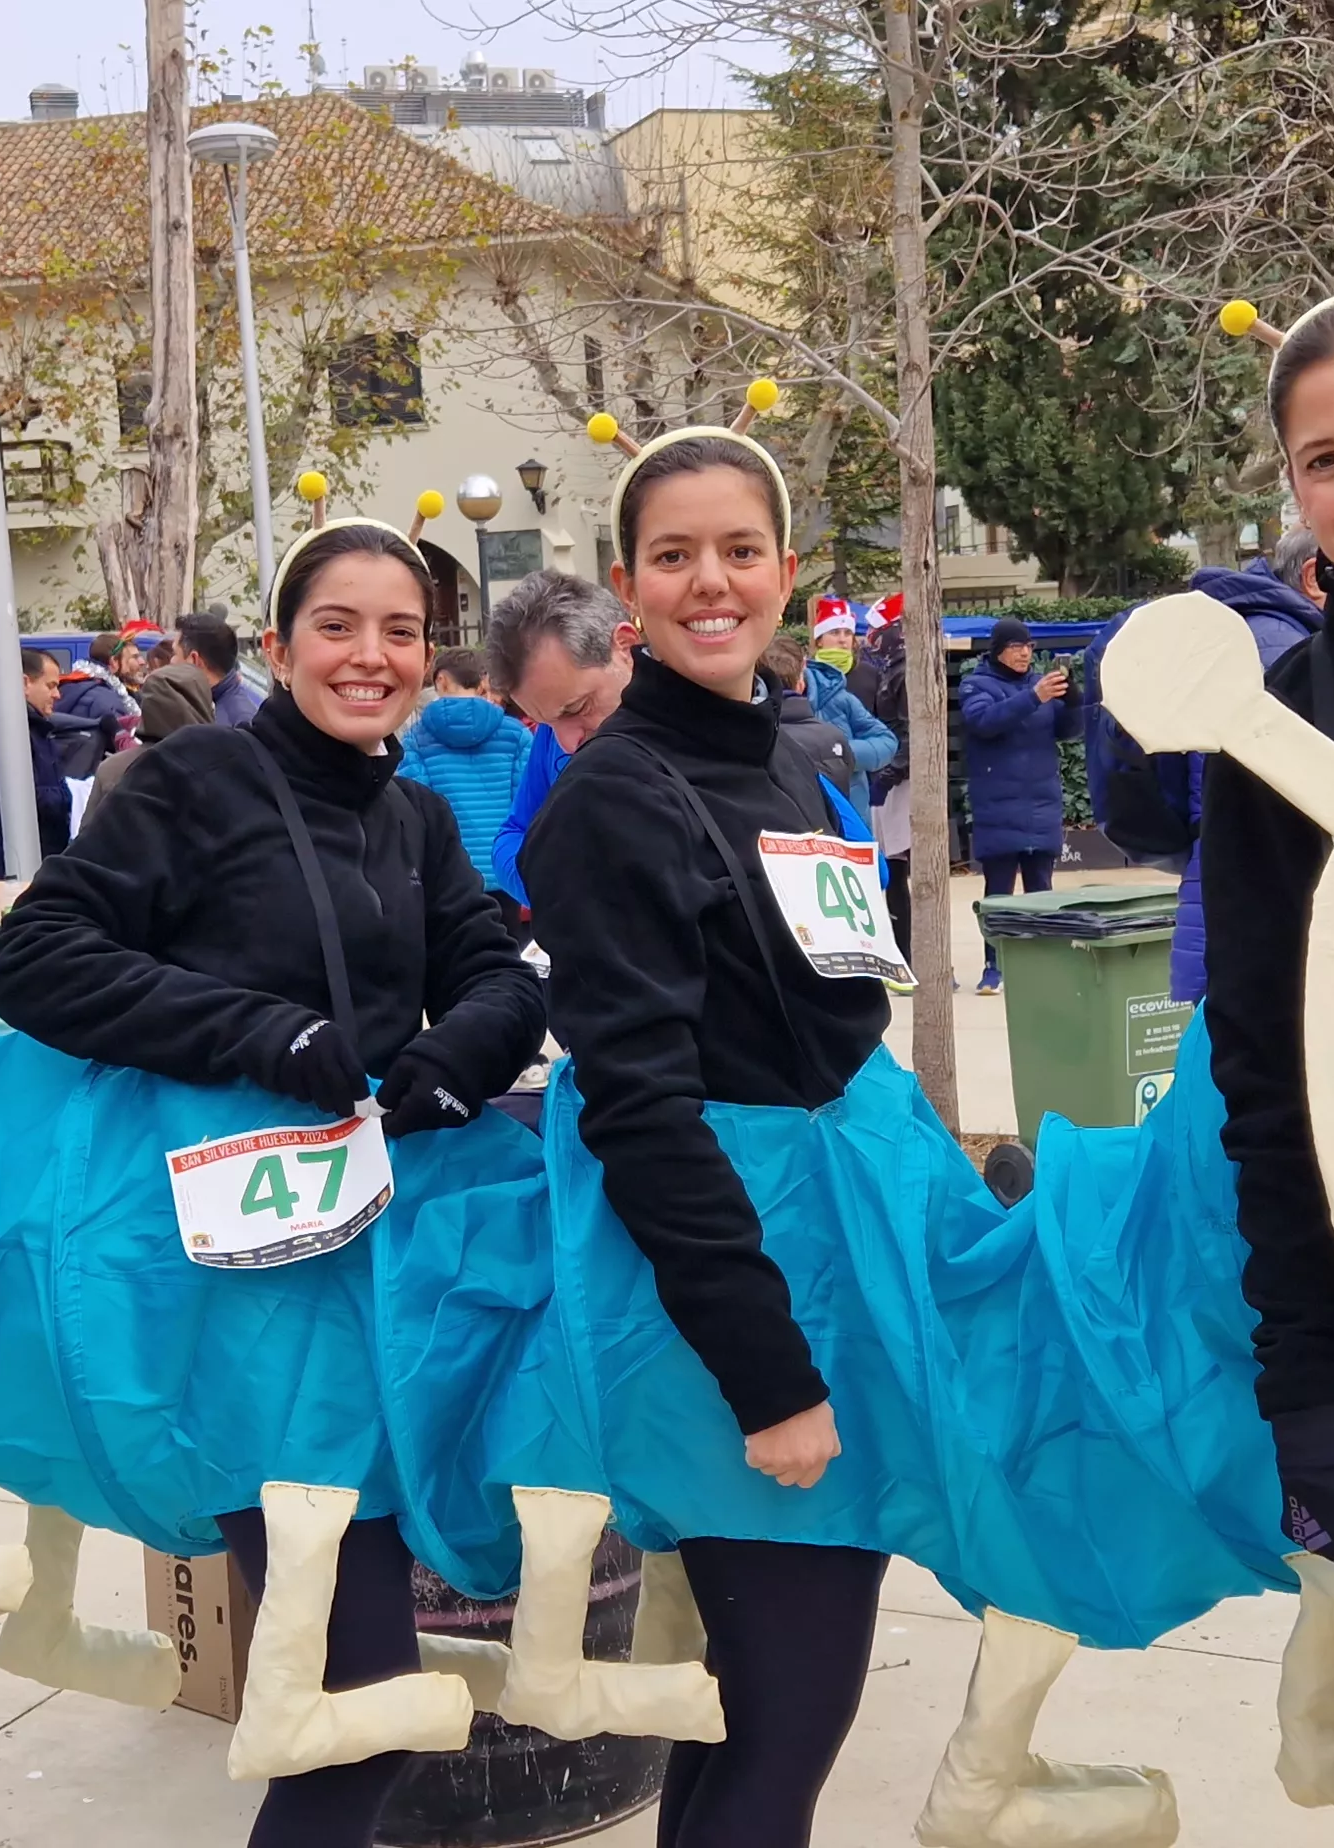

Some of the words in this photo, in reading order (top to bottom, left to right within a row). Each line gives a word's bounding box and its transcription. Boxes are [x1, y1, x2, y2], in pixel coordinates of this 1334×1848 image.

[816, 861, 876, 937] 49
[179, 1155, 202, 1170] SAN
[203, 1138, 257, 1163] SILVESTRE
[259, 1132, 301, 1148] HUESCA
[302, 1130, 329, 1144] 2024
[240, 1145, 348, 1220] 47
[290, 1220, 325, 1232] MARIA
